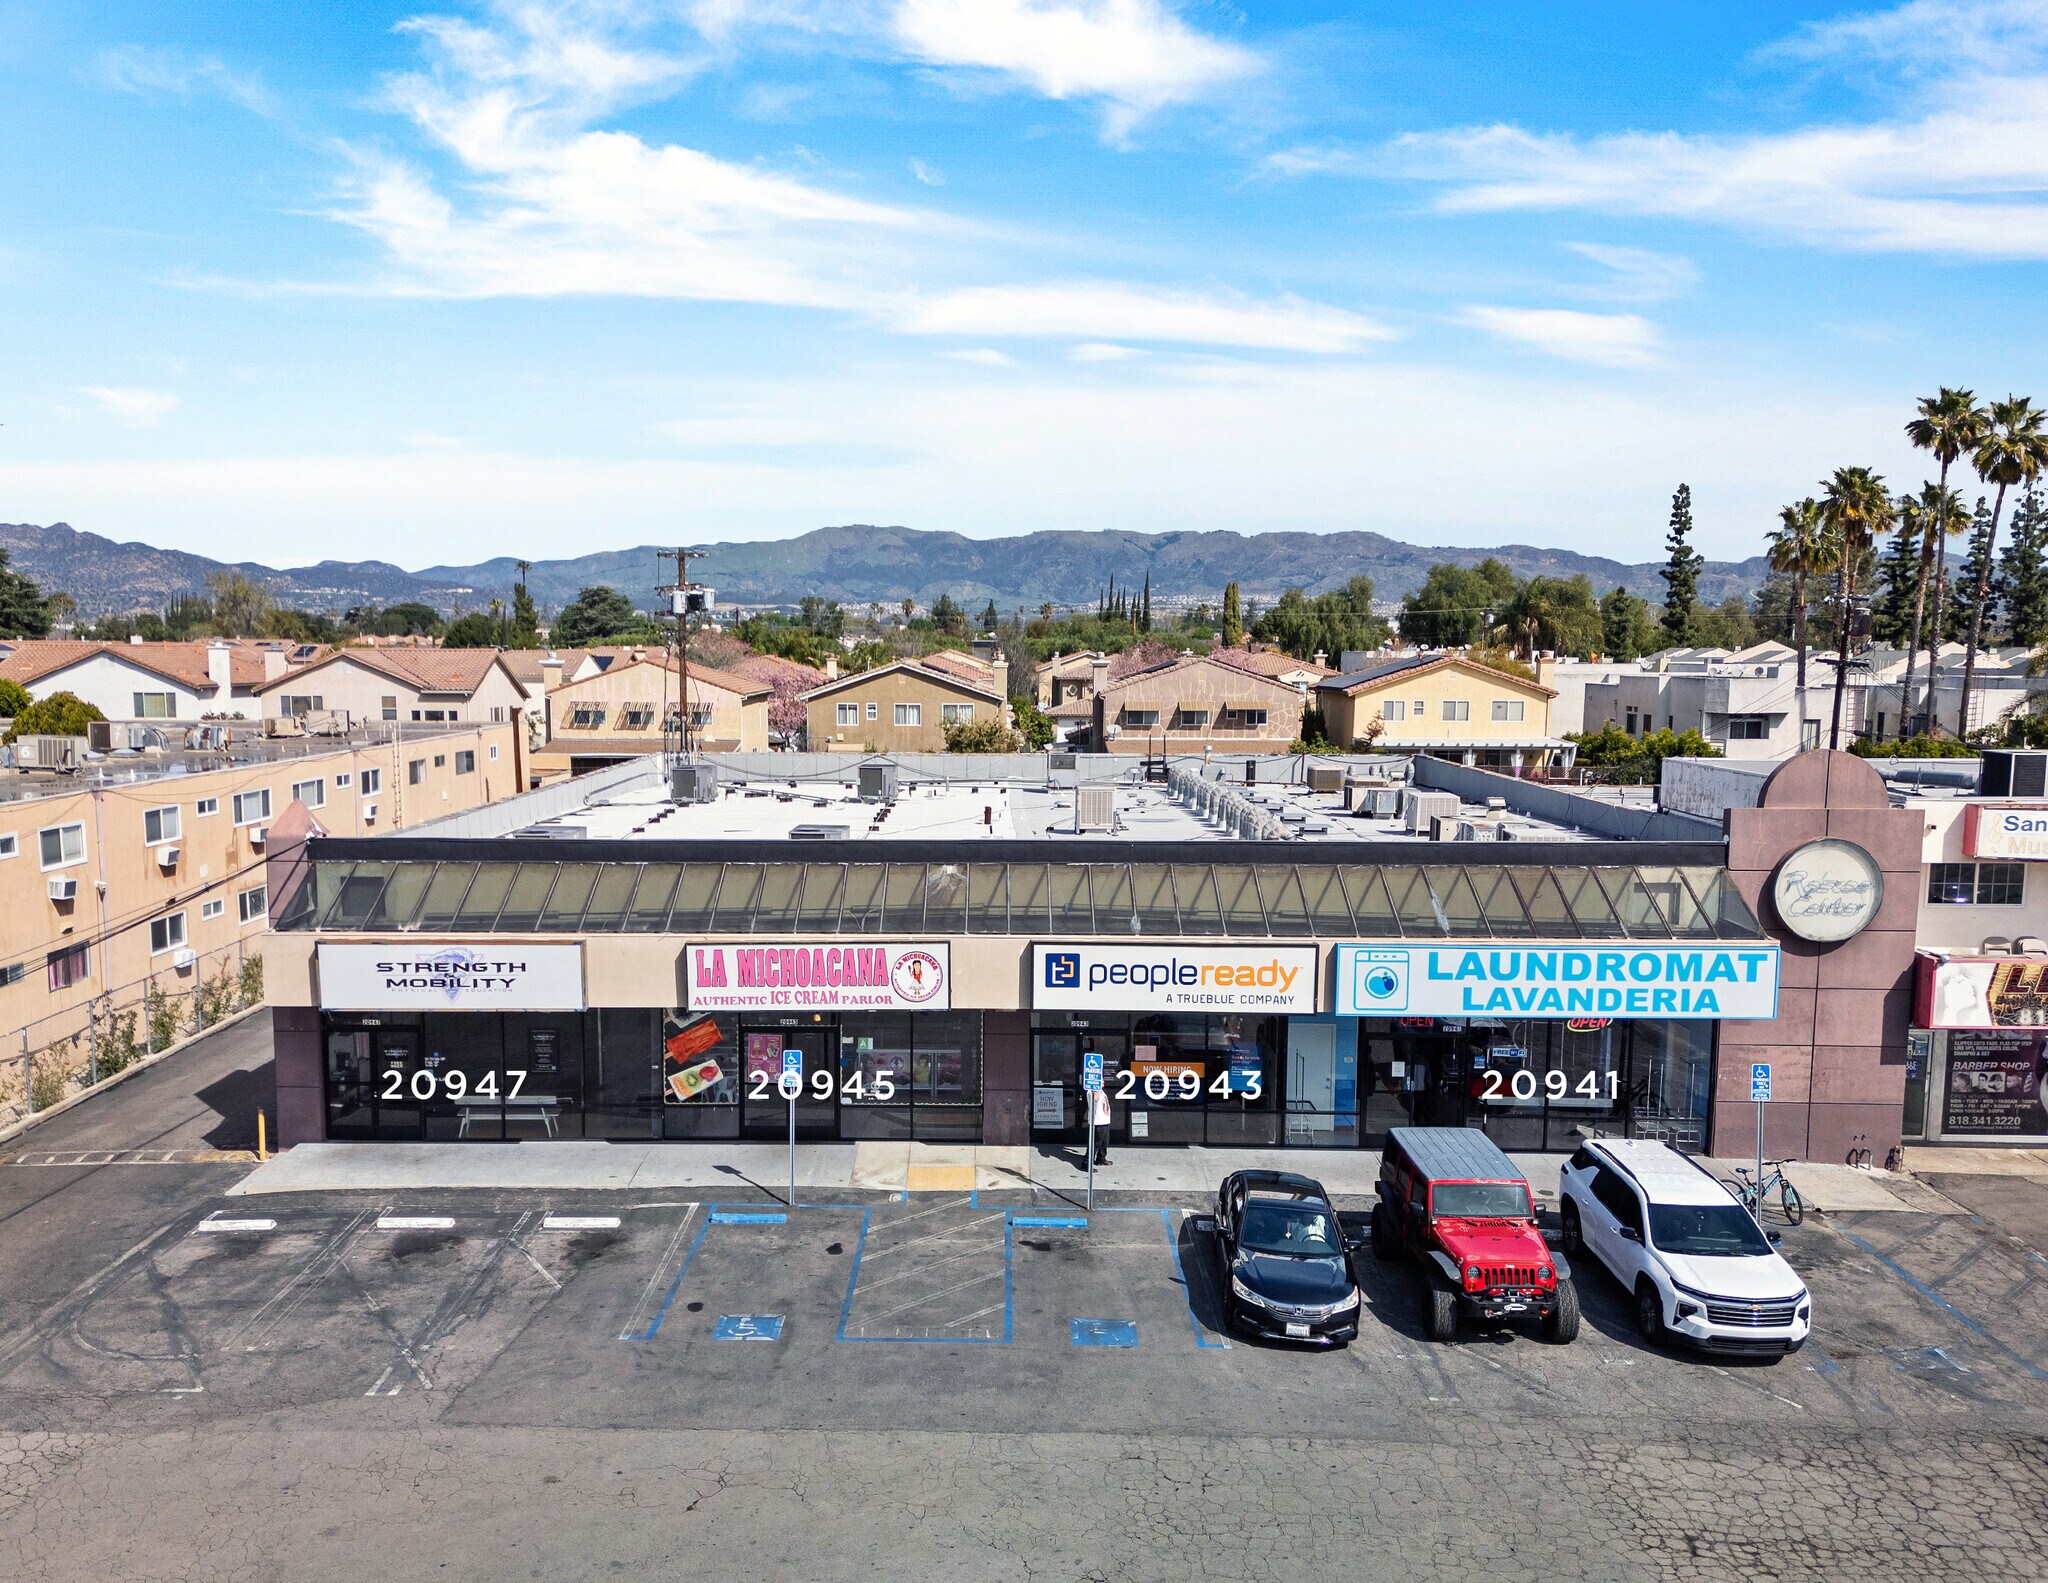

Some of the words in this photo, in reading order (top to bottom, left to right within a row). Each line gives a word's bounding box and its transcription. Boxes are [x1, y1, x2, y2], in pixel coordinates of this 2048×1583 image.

[21, 746, 31, 758] 6
[376, 962, 527, 973] STRENGTH
[696, 949, 728, 987] LA
[737, 948, 889, 987] MICHOACANA
[1427, 952, 1769, 983] LAUNDROMAT
[1089, 958, 1298, 993] peopleready
[387, 978, 516, 989] MOBILITY
[693, 996, 767, 1006] AUTHENTIC
[770, 991, 790, 1005] ICE
[794, 991, 839, 1005] CREAM
[842, 995, 893, 1005] PARLOR
[1166, 994, 1173, 1004] A
[1177, 994, 1236, 1005] TRUEBLUE
[1240, 995, 1295, 1006] COMPANY
[1462, 987, 1720, 1013] LAVANDERIA
[1570, 1018, 1608, 1028] OPEN
[1953, 1062, 1998, 1070] BARBER
[2001, 1062, 2030, 1070] SHOP
[1949, 1116, 2021, 1125] 818.341.3220
